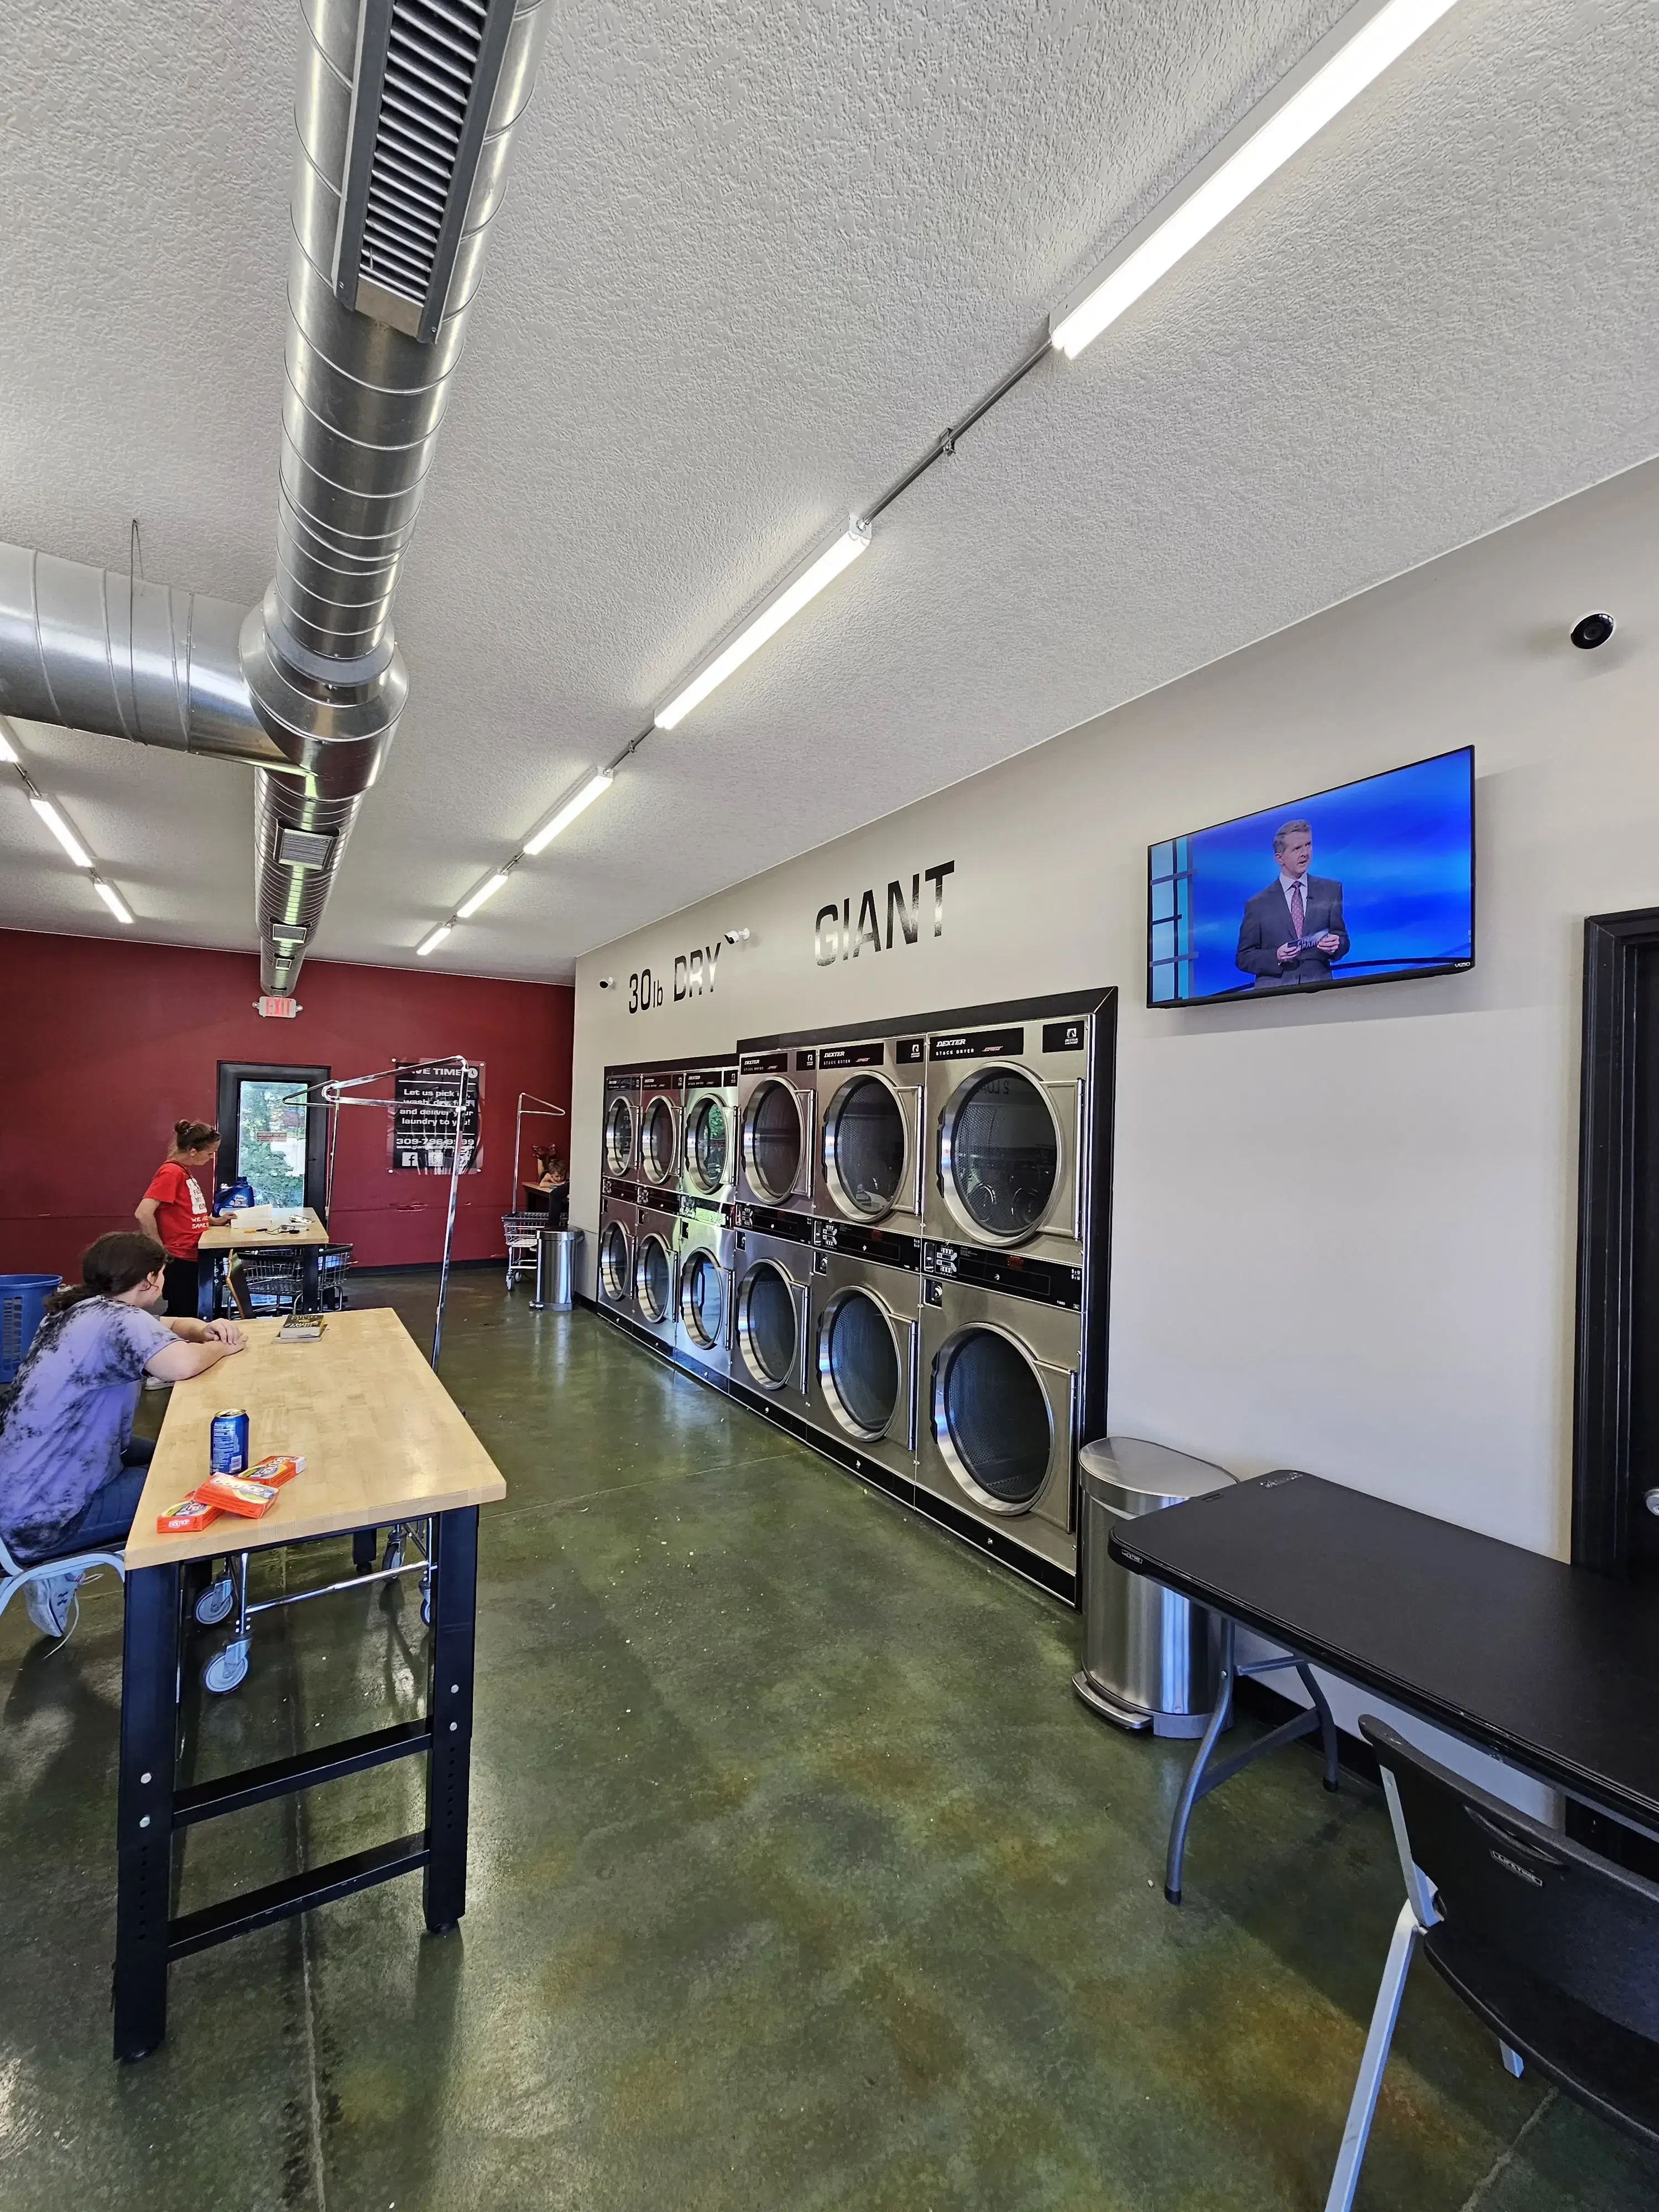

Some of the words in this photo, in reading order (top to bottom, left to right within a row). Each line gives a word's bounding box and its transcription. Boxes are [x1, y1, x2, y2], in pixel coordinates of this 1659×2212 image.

[815, 860, 955, 967] GIANT
[674, 943, 721, 1001] DRY
[266, 998, 291, 1016] EXIT
[936, 1039, 966, 1047] DEXTER
[402, 1118, 437, 1126] laundry
